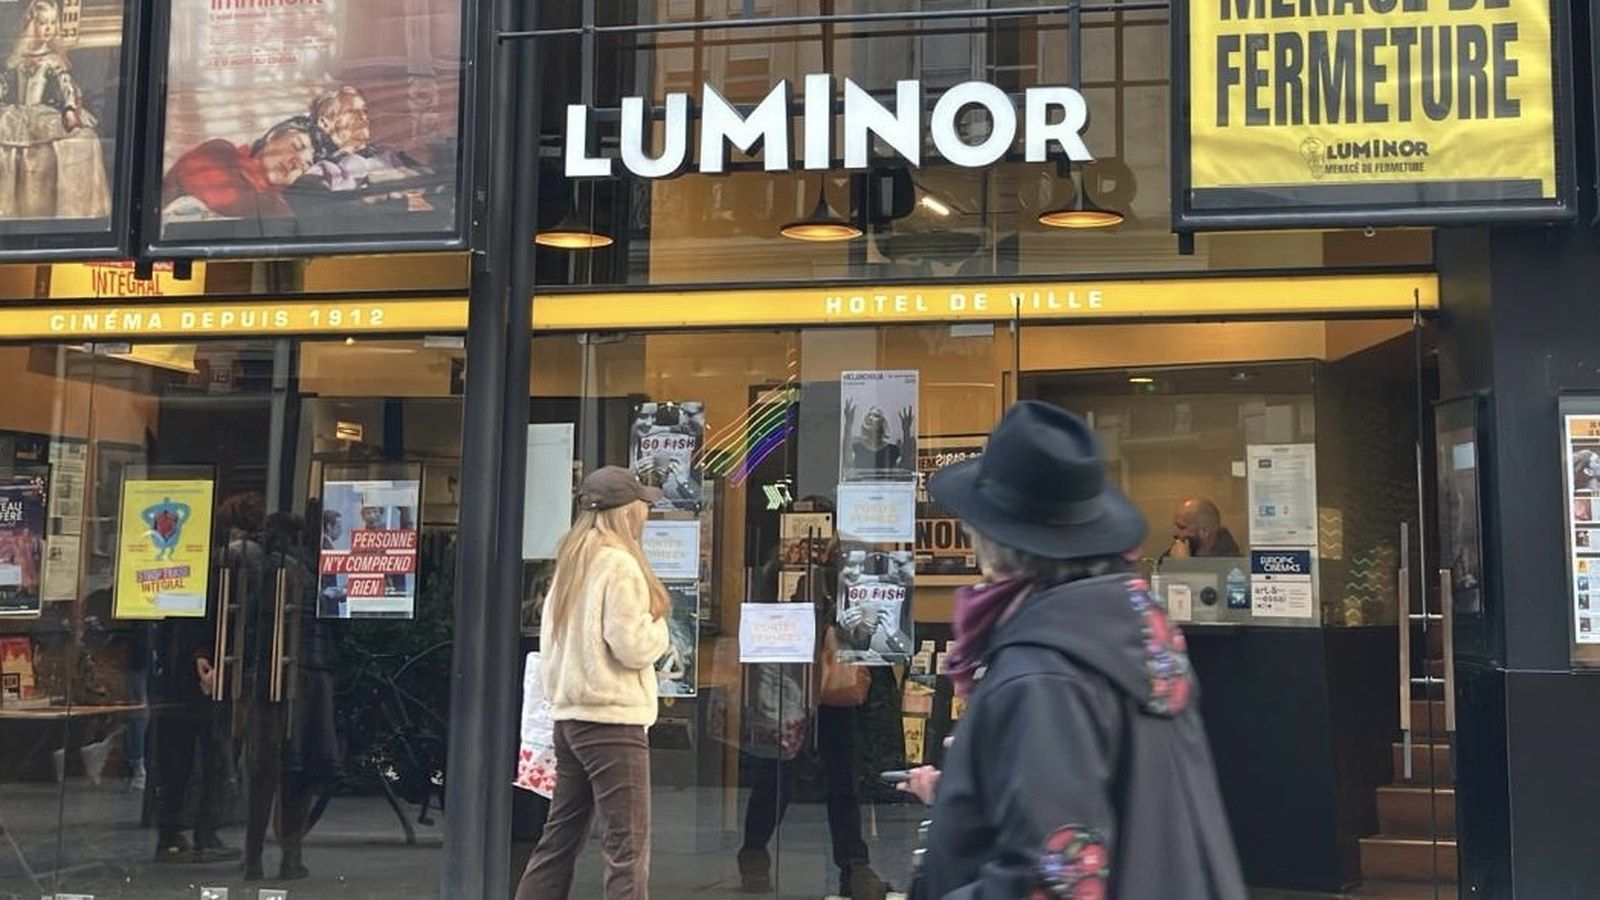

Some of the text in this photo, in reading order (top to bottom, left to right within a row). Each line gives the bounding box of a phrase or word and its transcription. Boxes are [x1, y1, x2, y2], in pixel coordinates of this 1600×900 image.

[1216, 22, 1521, 127] FERMETURE
[565, 73, 1094, 178] LUMINOR
[1327, 139, 1429, 159] LUMINOR
[1361, 163, 1373, 173] DE
[1375, 161, 1424, 173] FERMETURE
[92, 269, 164, 296] INTÉGRAL
[825, 290, 1104, 314] HOTEL DE VILLE
[50, 308, 385, 332] CINÉMA DEPUIS 1912
[642, 438, 696, 450] GO FISH
[353, 532, 416, 548] PERSONNE
[324, 556, 411, 572] N'Y COMPREND
[351, 580, 380, 596] RIEN
[850, 588, 904, 600] GO FISH
